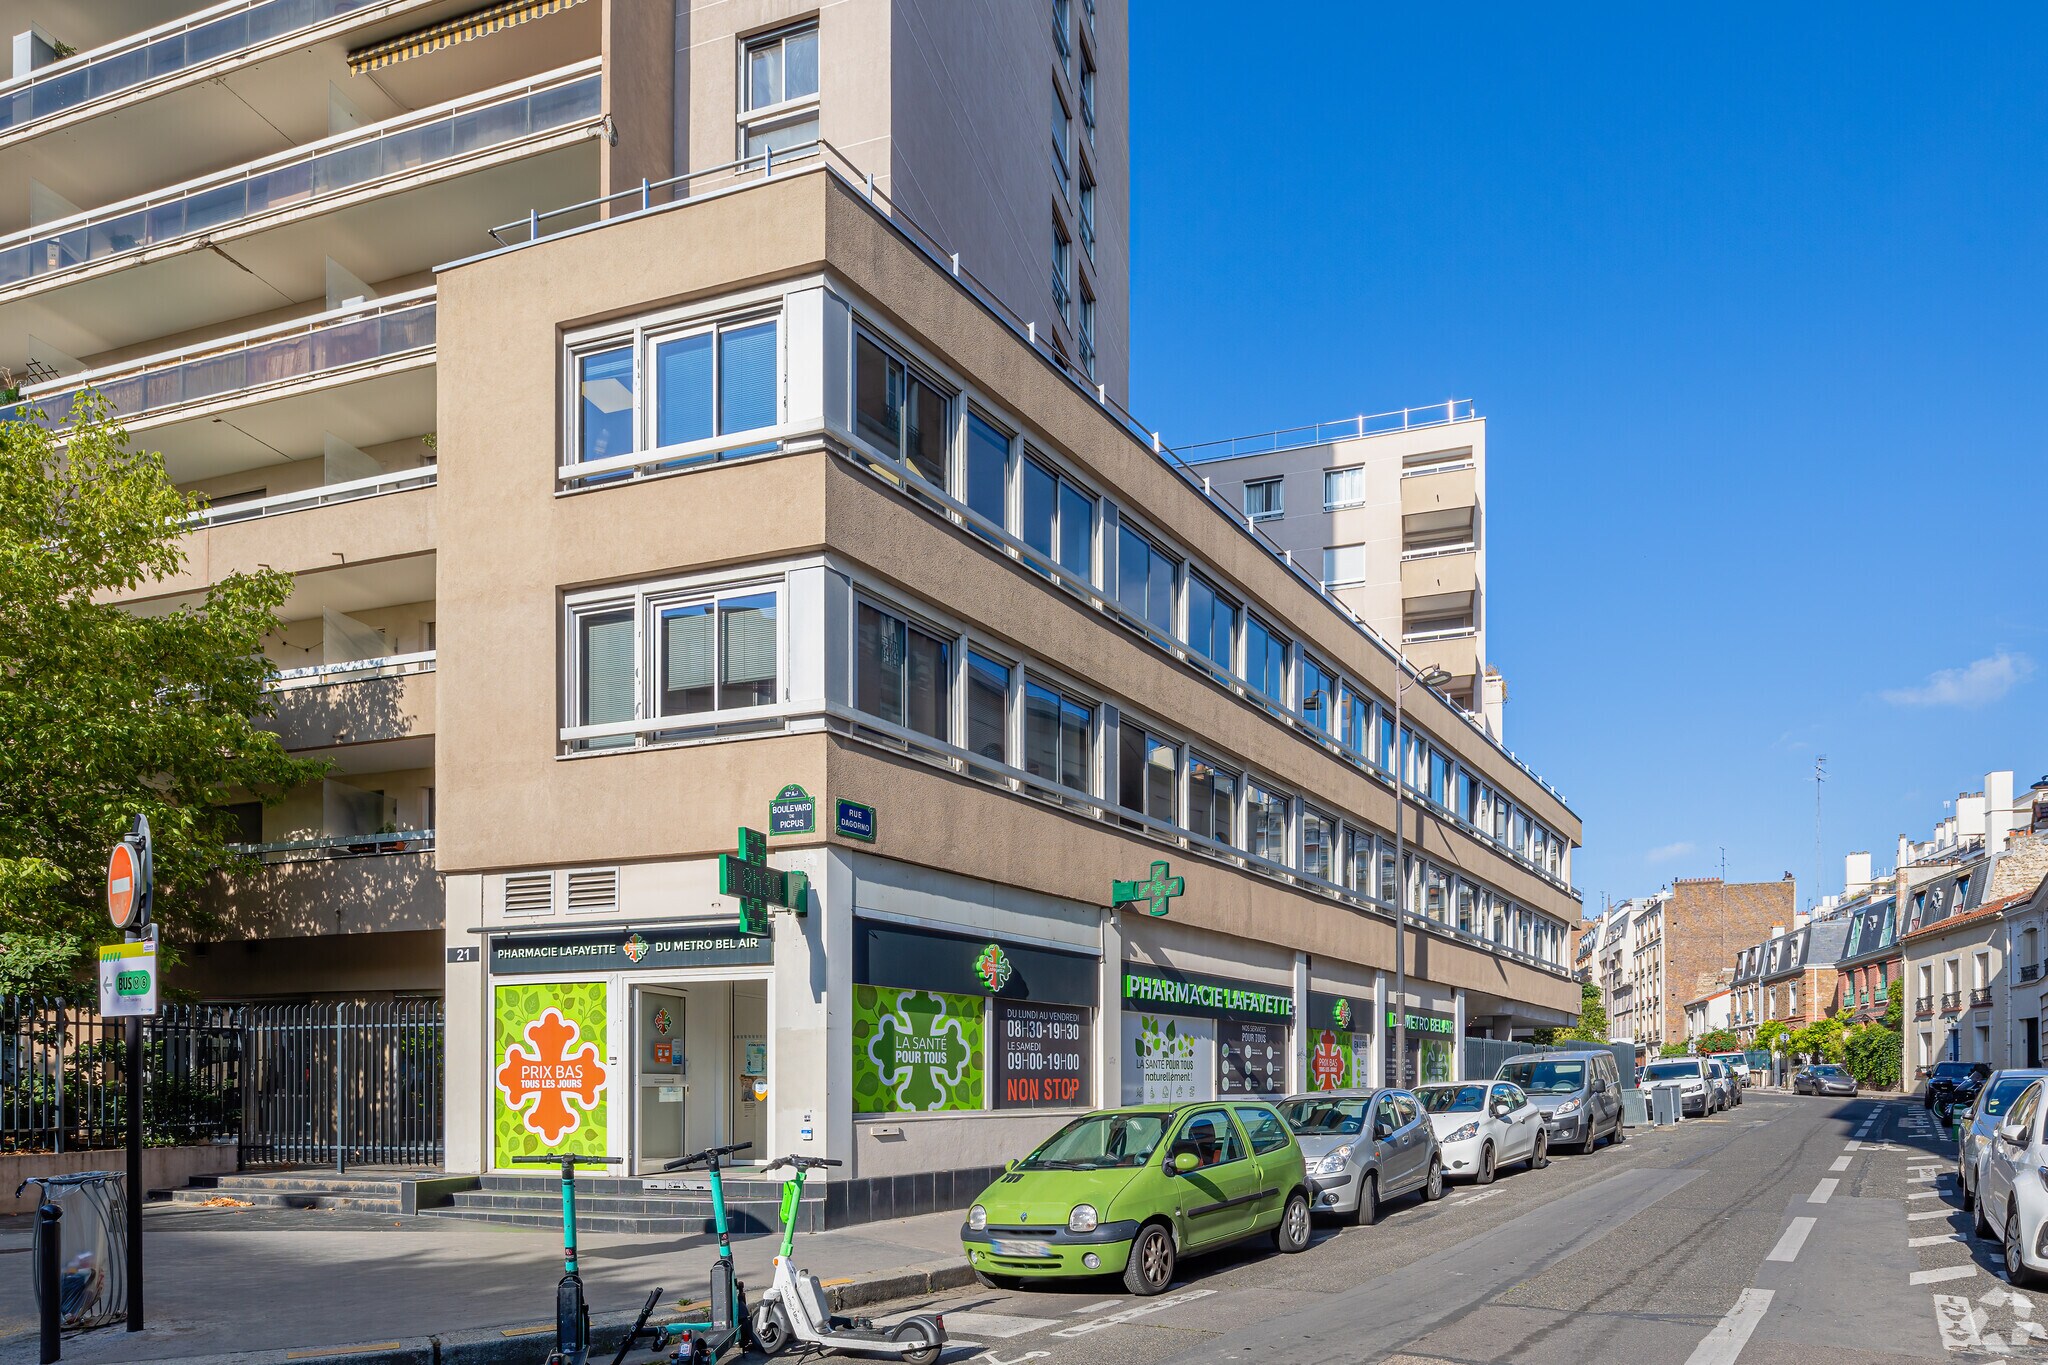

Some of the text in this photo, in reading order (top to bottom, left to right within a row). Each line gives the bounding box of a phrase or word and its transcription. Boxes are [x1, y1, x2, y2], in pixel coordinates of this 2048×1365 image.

[772, 803, 812, 814] BOULEVARD
[849, 808, 863, 819] RUE
[780, 819, 804, 829] PICPUS
[841, 818, 870, 832] DAGORNO
[497, 946, 559, 959] PHARMACIE
[559, 943, 617, 957] LAFAYETTE
[655, 941, 671, 952] DU
[673, 939, 713, 951] METRO
[715, 938, 736, 949] BEL
[738, 937, 758, 948] AIR
[456, 948, 470, 961] 21
[118, 976, 132, 990] BUS
[1127, 974, 1293, 1015] PHARMACIE LAFAYETTE
[1007, 1008, 1080, 1022] DU LUNDI AU VENDREDI
[1007, 1020, 1079, 1040] 08H30-19H30
[896, 1035, 947, 1051] LA SANTÉ
[1242, 1033, 1254, 1042] POUR
[1007, 1041, 1041, 1051] LE SAMEDI
[895, 1050, 947, 1064] POUR TOUS
[1007, 1052, 1080, 1070] 09H00-19H00
[1136, 1059, 1144, 1069] LA
[1165, 1059, 1179, 1070] POUR
[1180, 1060, 1194, 1070] TOUS
[521, 1065, 583, 1079] PRIX BAS
[521, 1079, 582, 1088] TOUS LES JOURS
[1007, 1078, 1079, 1101] NON STOP
